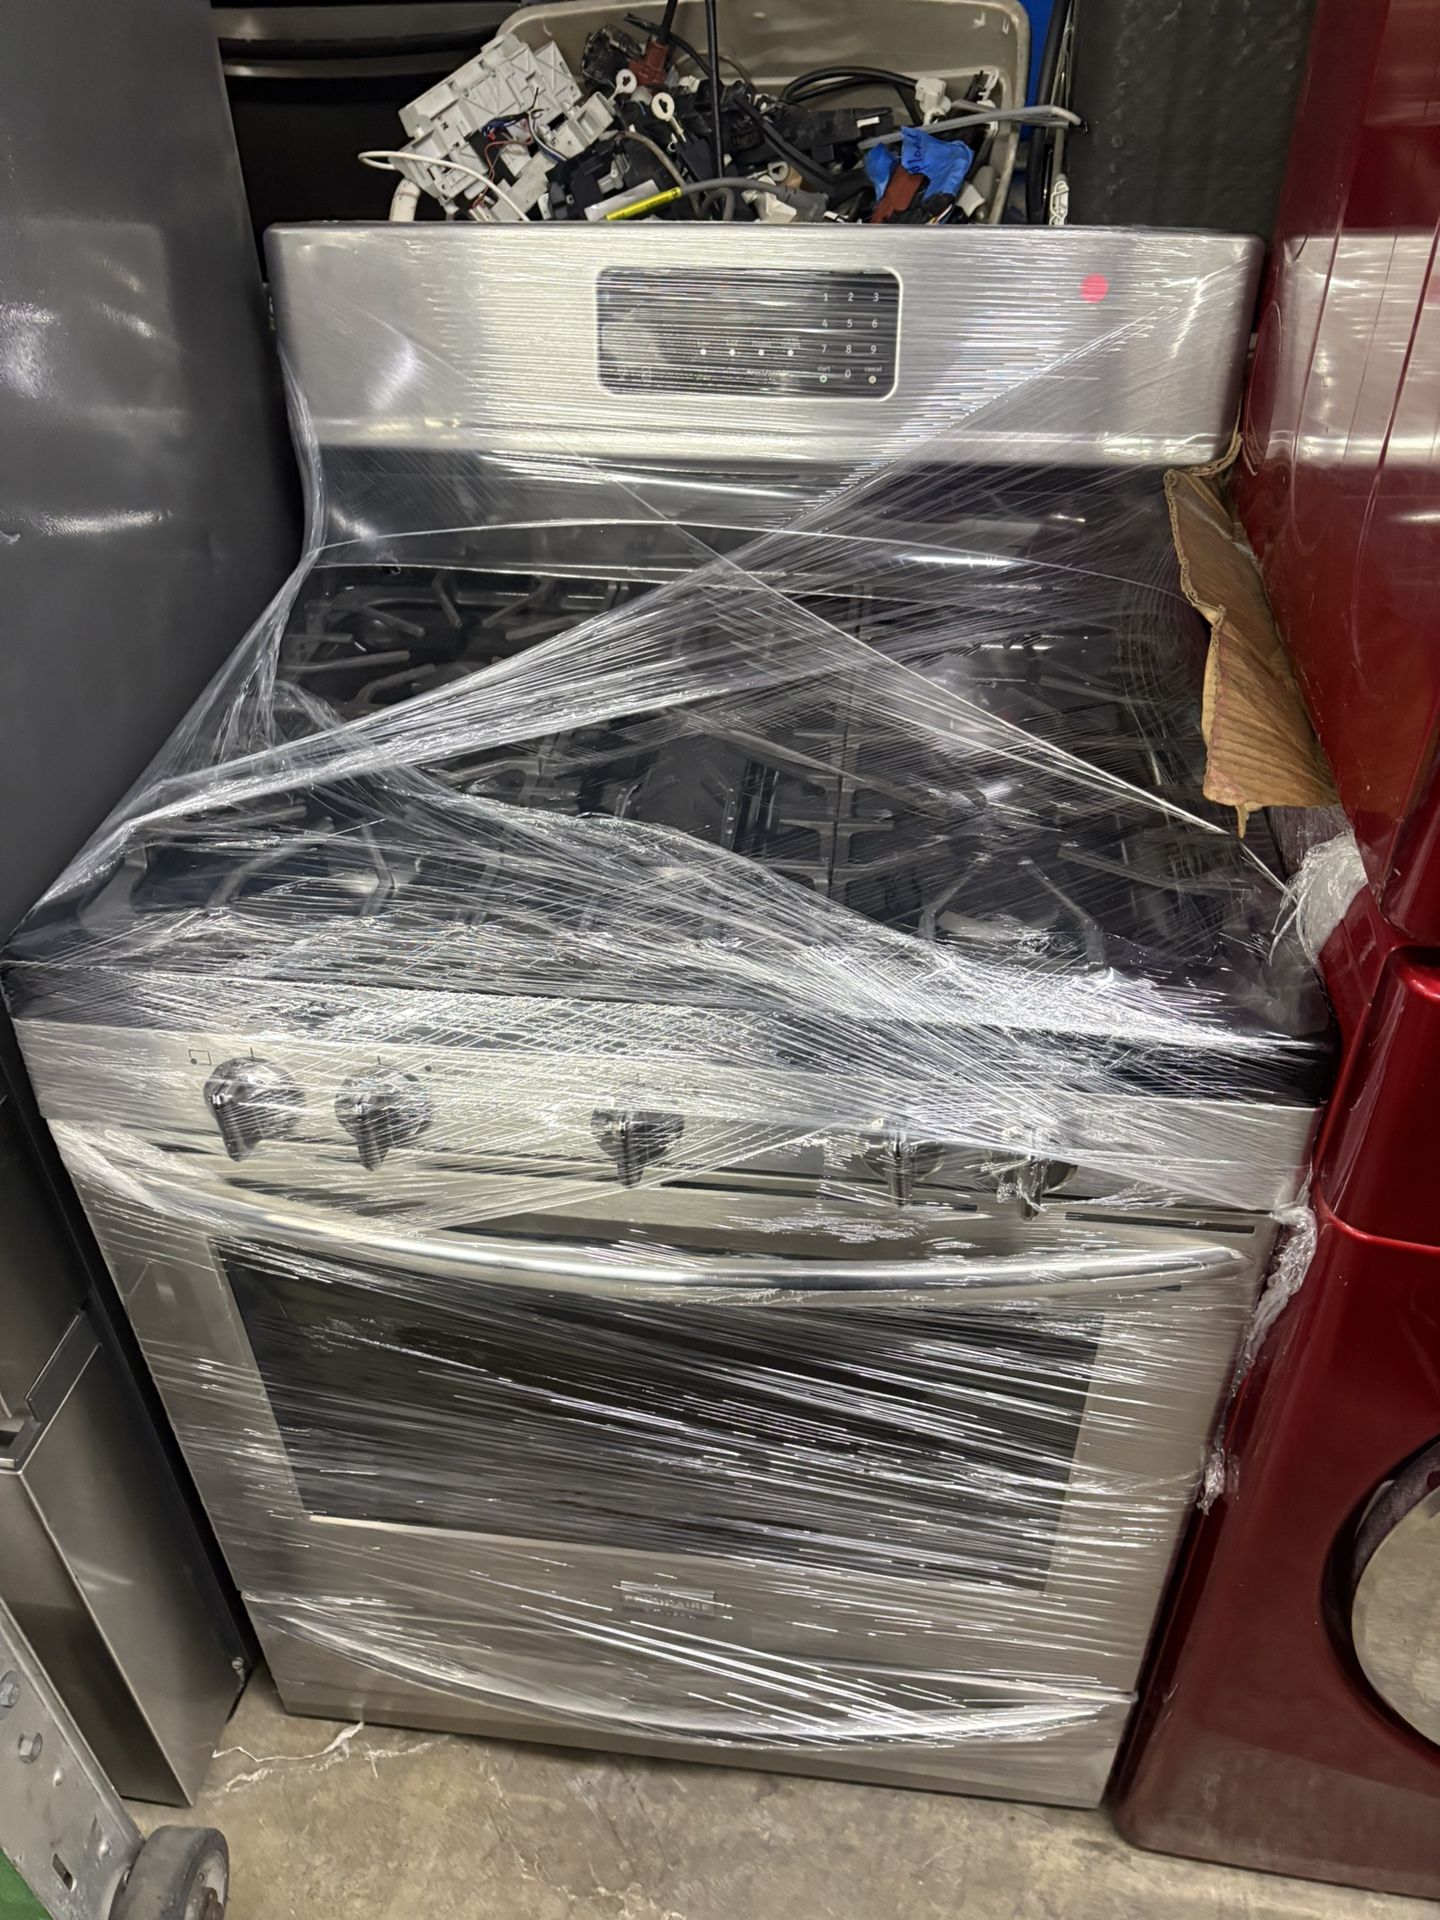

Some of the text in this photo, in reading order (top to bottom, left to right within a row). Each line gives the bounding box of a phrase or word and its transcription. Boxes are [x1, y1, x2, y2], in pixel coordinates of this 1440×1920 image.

[847, 292, 854, 302] 2
[873, 292, 879, 302] 3
[822, 319, 878, 328] 4 5 6
[821, 344, 877, 354] 7 8 9
[845, 369, 851, 378] 0
[624, 1595, 711, 1610] FRGIDAIRE
